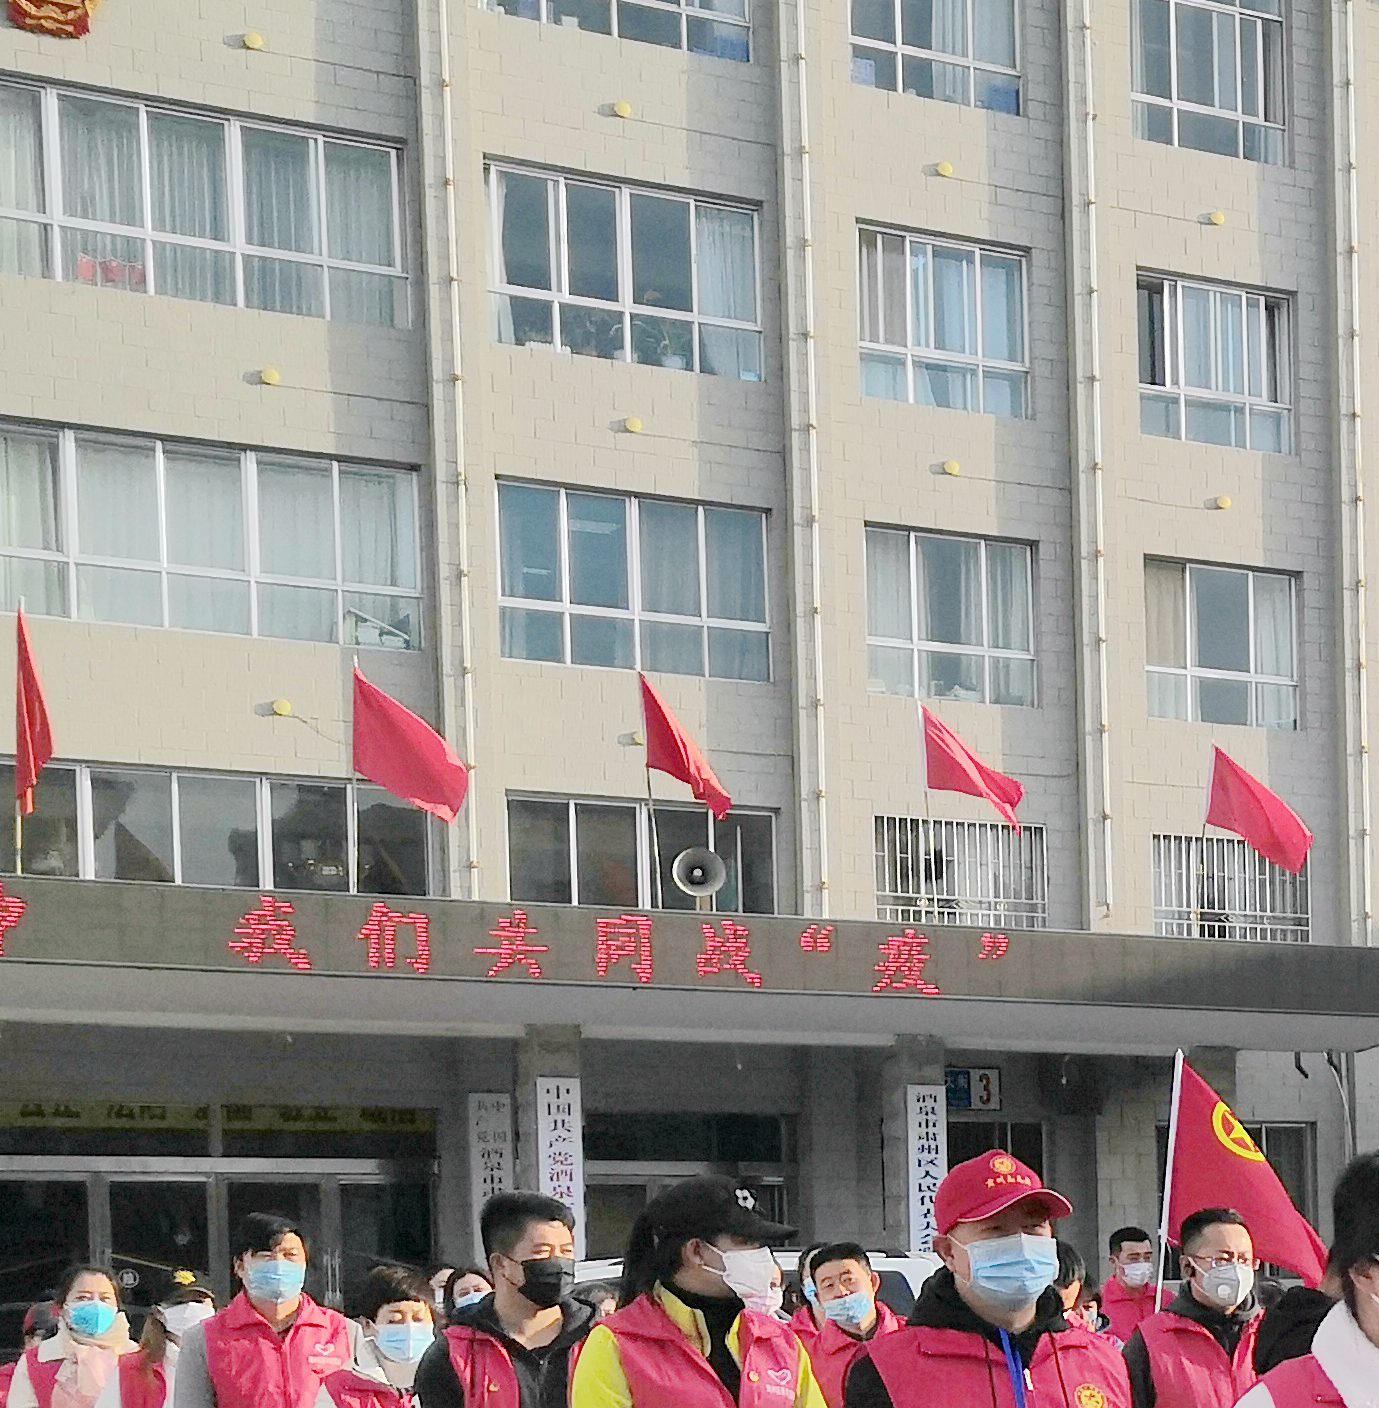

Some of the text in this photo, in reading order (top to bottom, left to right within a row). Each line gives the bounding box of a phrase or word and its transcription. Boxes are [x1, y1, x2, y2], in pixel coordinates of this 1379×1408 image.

[978, 1072, 992, 1106] 3
[546, 1085, 574, 1207] 中国共产党酒泉
